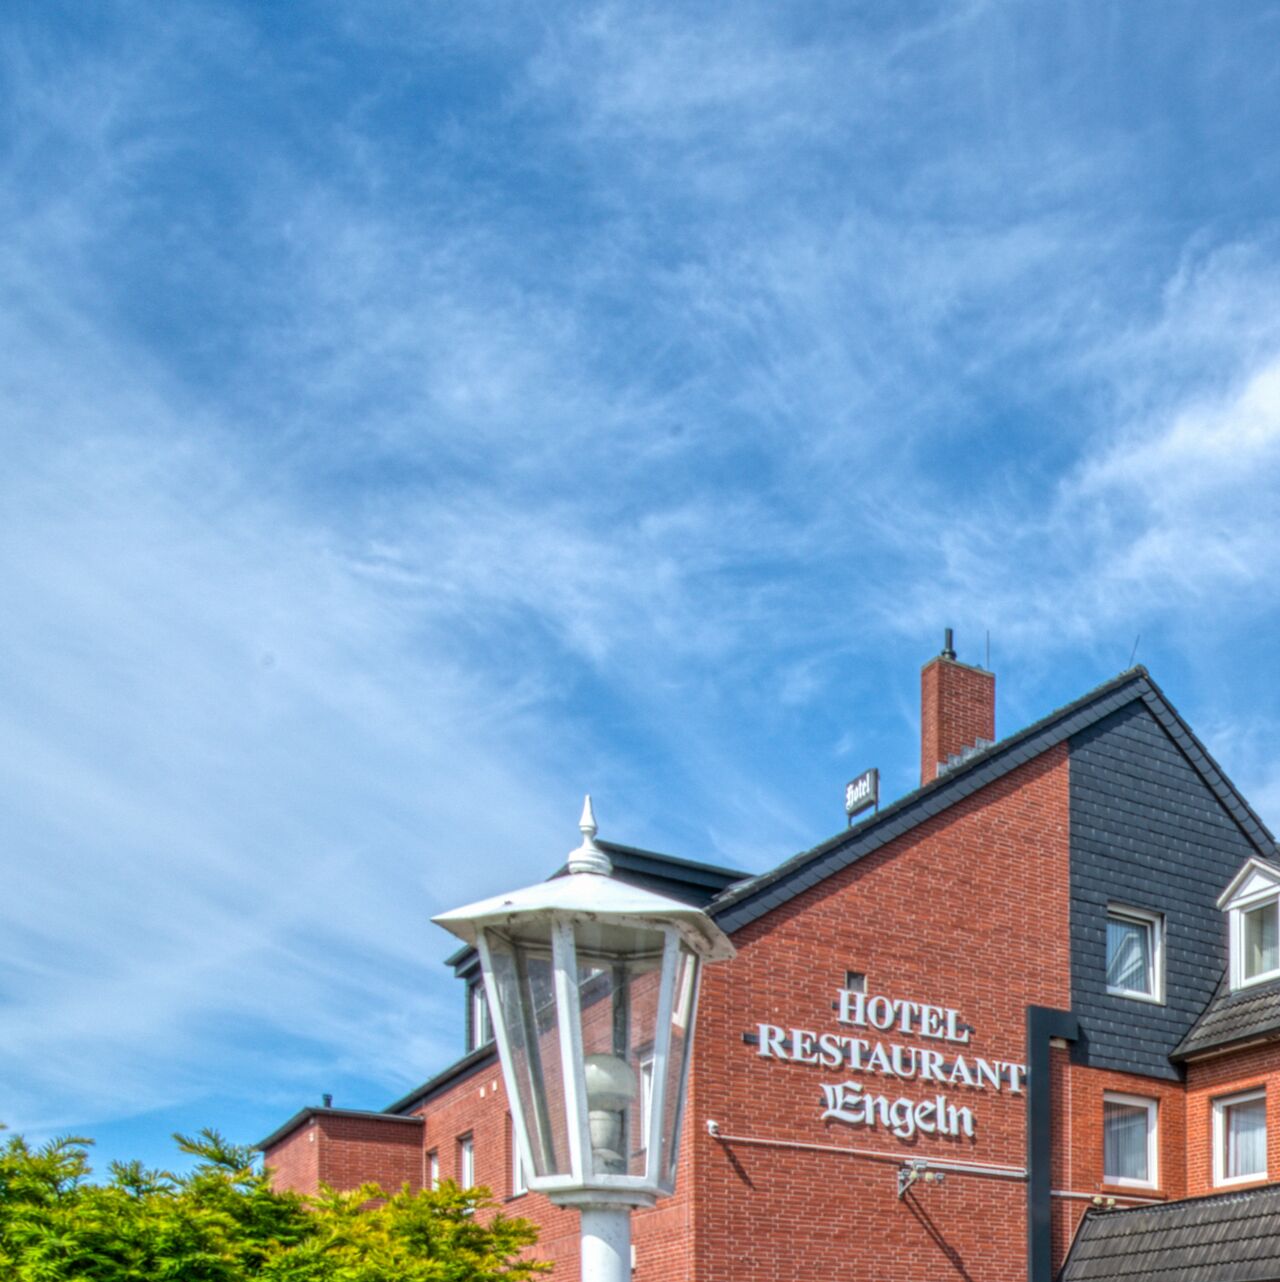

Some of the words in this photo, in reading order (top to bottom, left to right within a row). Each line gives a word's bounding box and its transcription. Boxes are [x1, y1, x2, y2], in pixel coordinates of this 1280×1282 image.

[836, 988, 970, 1043] HOTEL
[756, 1023, 1027, 1093] RESTAURANT
[819, 1080, 975, 1138] Engeln
